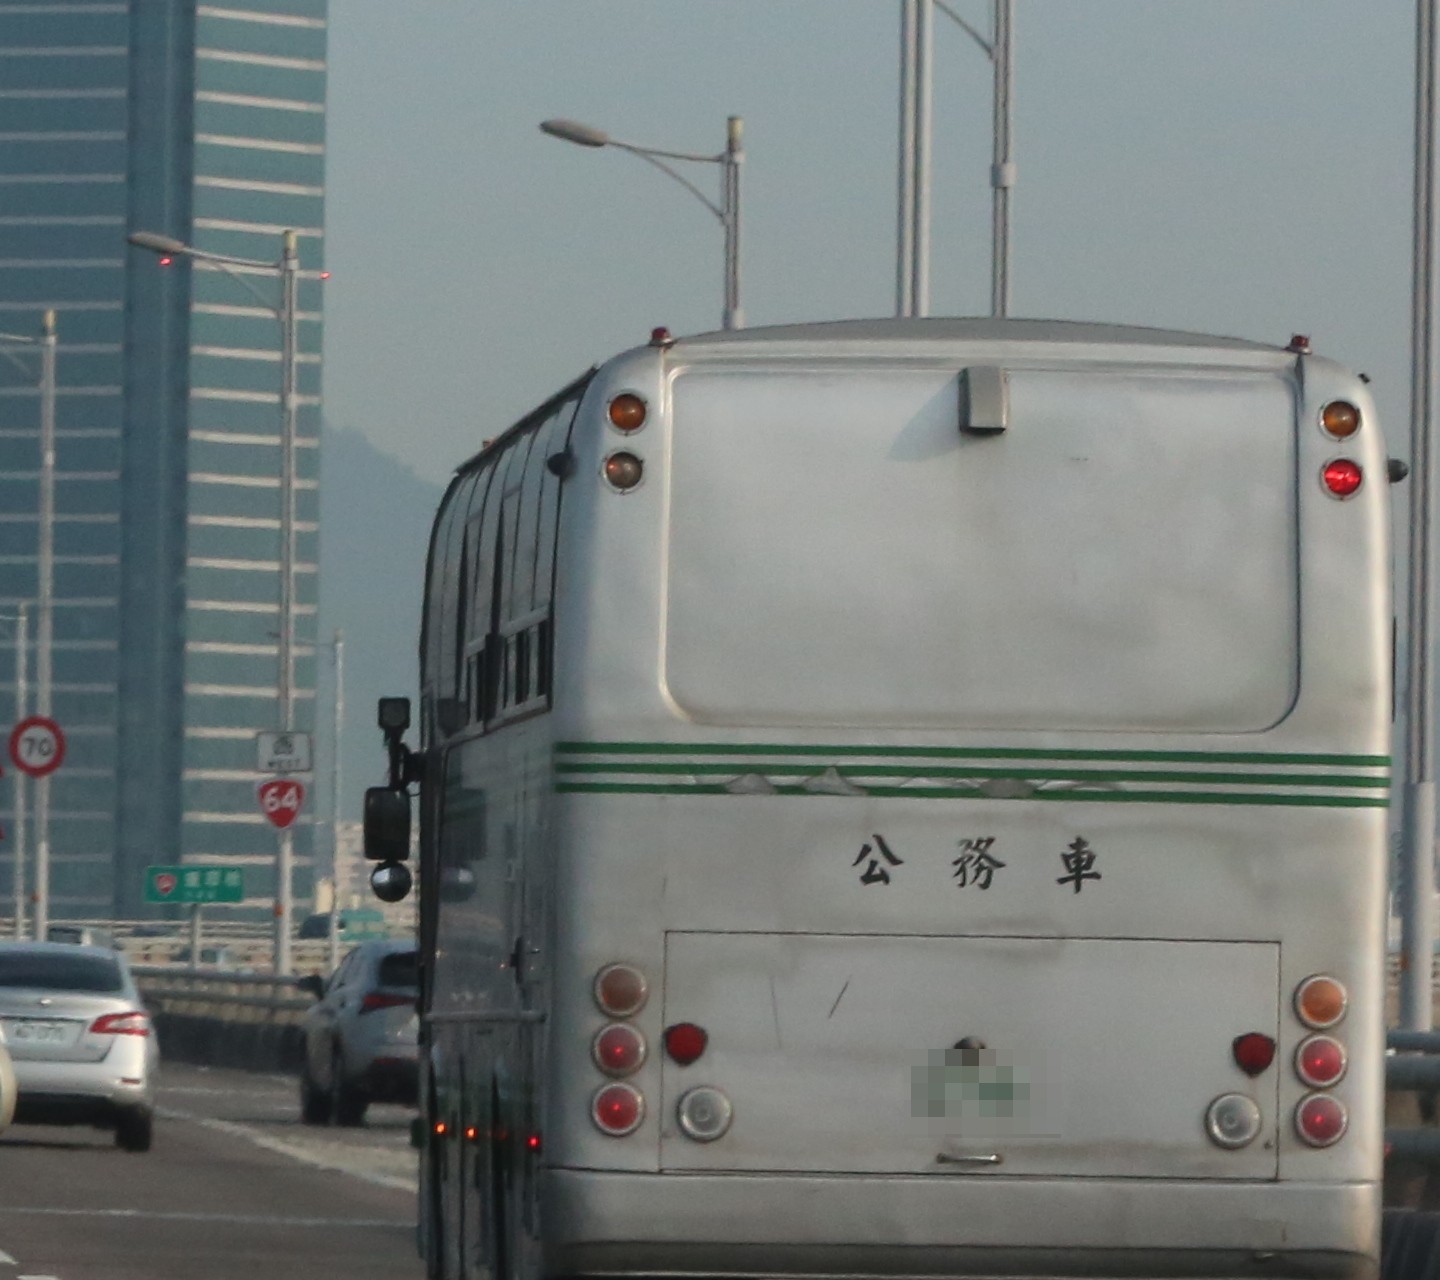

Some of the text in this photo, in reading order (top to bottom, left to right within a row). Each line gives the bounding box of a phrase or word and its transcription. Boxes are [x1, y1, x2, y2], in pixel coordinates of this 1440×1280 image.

[23, 736, 54, 756] 70
[263, 786, 298, 811] 64
[852, 833, 1102, 894] 公務車
